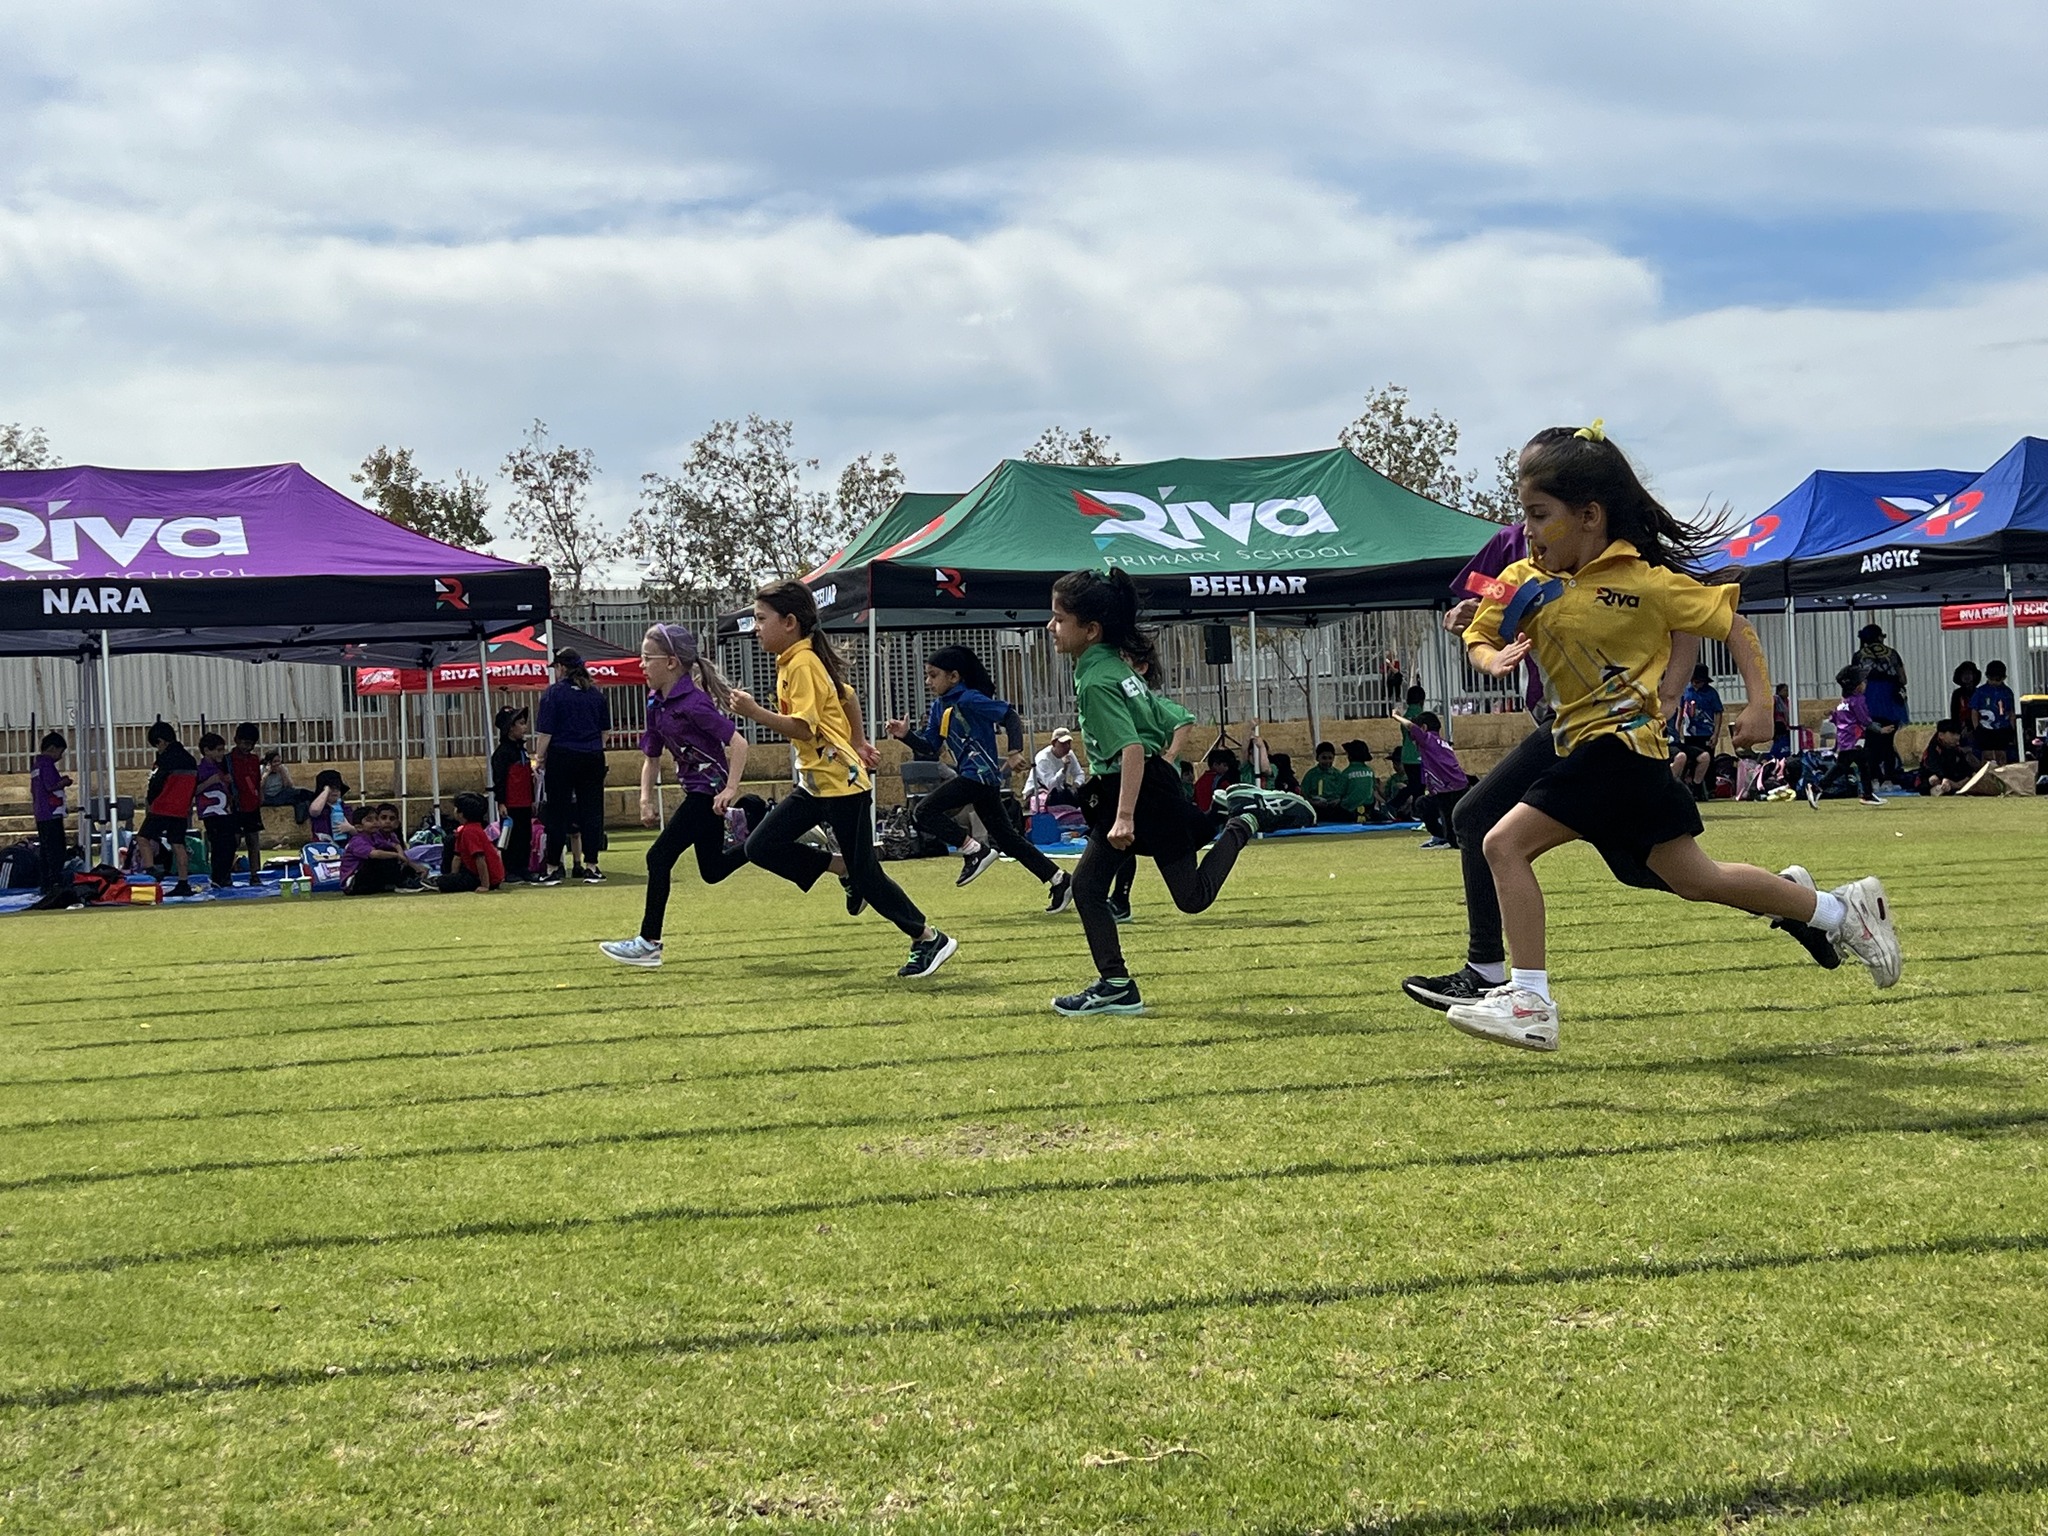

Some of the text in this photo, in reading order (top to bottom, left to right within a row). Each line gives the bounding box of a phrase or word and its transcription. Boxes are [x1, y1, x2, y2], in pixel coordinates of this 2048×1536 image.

[1071, 485, 1340, 550] Riva
[1103, 546, 1358, 568] PRIMARY SCHOOL
[1861, 549, 1920, 574] ARGYLE
[1190, 575, 1307, 597] BEELIAR
[1594, 586, 1640, 608] Riva
[43, 587, 151, 614] NARA
[1960, 609, 1981, 621] RIVA
[441, 669, 479, 680] RIVA
